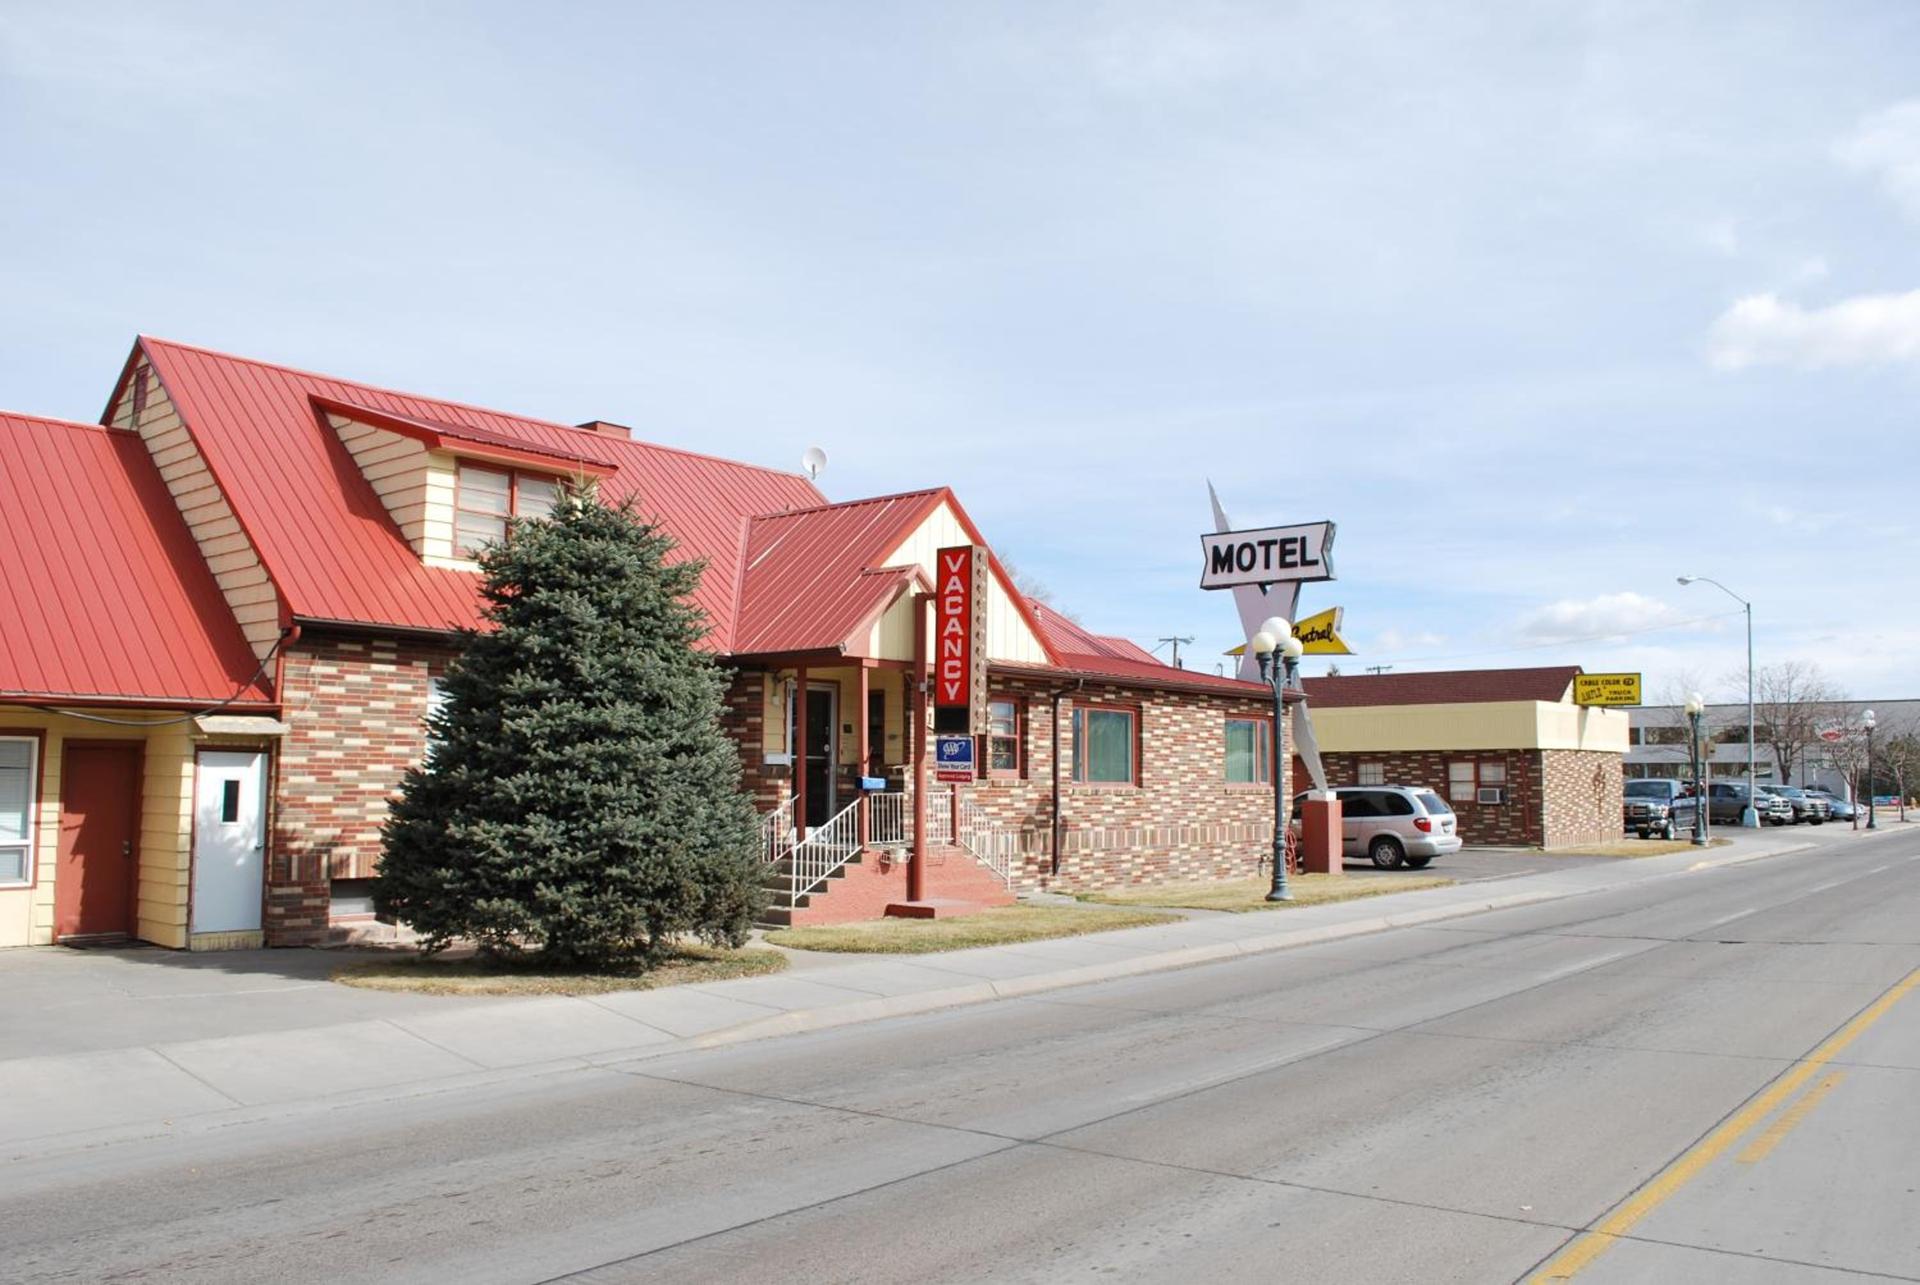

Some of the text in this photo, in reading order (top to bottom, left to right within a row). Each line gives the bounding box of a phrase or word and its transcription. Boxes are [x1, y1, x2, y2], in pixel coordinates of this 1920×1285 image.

[1211, 536, 1319, 575] MOTEL
[943, 554, 965, 700] VACANCY
[1291, 622, 1334, 644] Cntral
